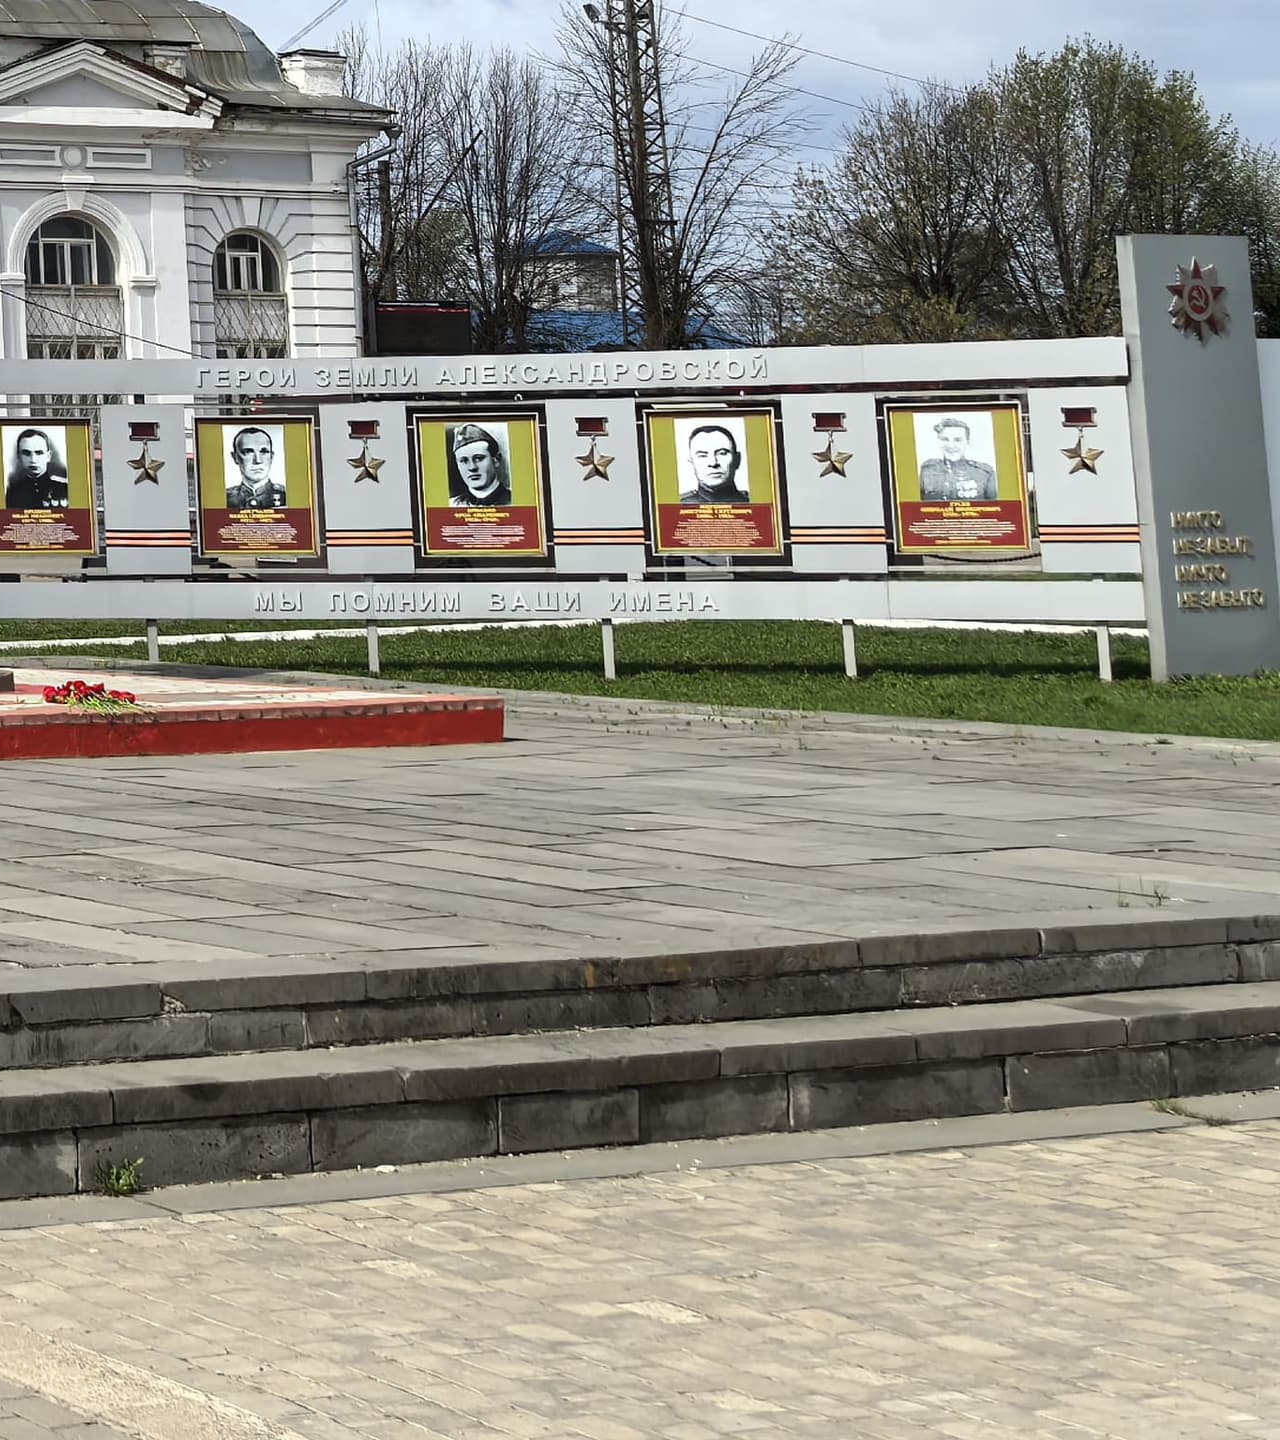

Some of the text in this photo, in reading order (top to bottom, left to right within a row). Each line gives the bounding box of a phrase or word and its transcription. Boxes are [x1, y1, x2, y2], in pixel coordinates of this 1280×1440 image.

[195, 353, 770, 390] ГЕРОИ ЗЕМЛИ АЛЕКСАНДРОВСКОЙ
[254, 590, 720, 613] МЫ ПОМНИМ ВАШИ ИМЕНА
